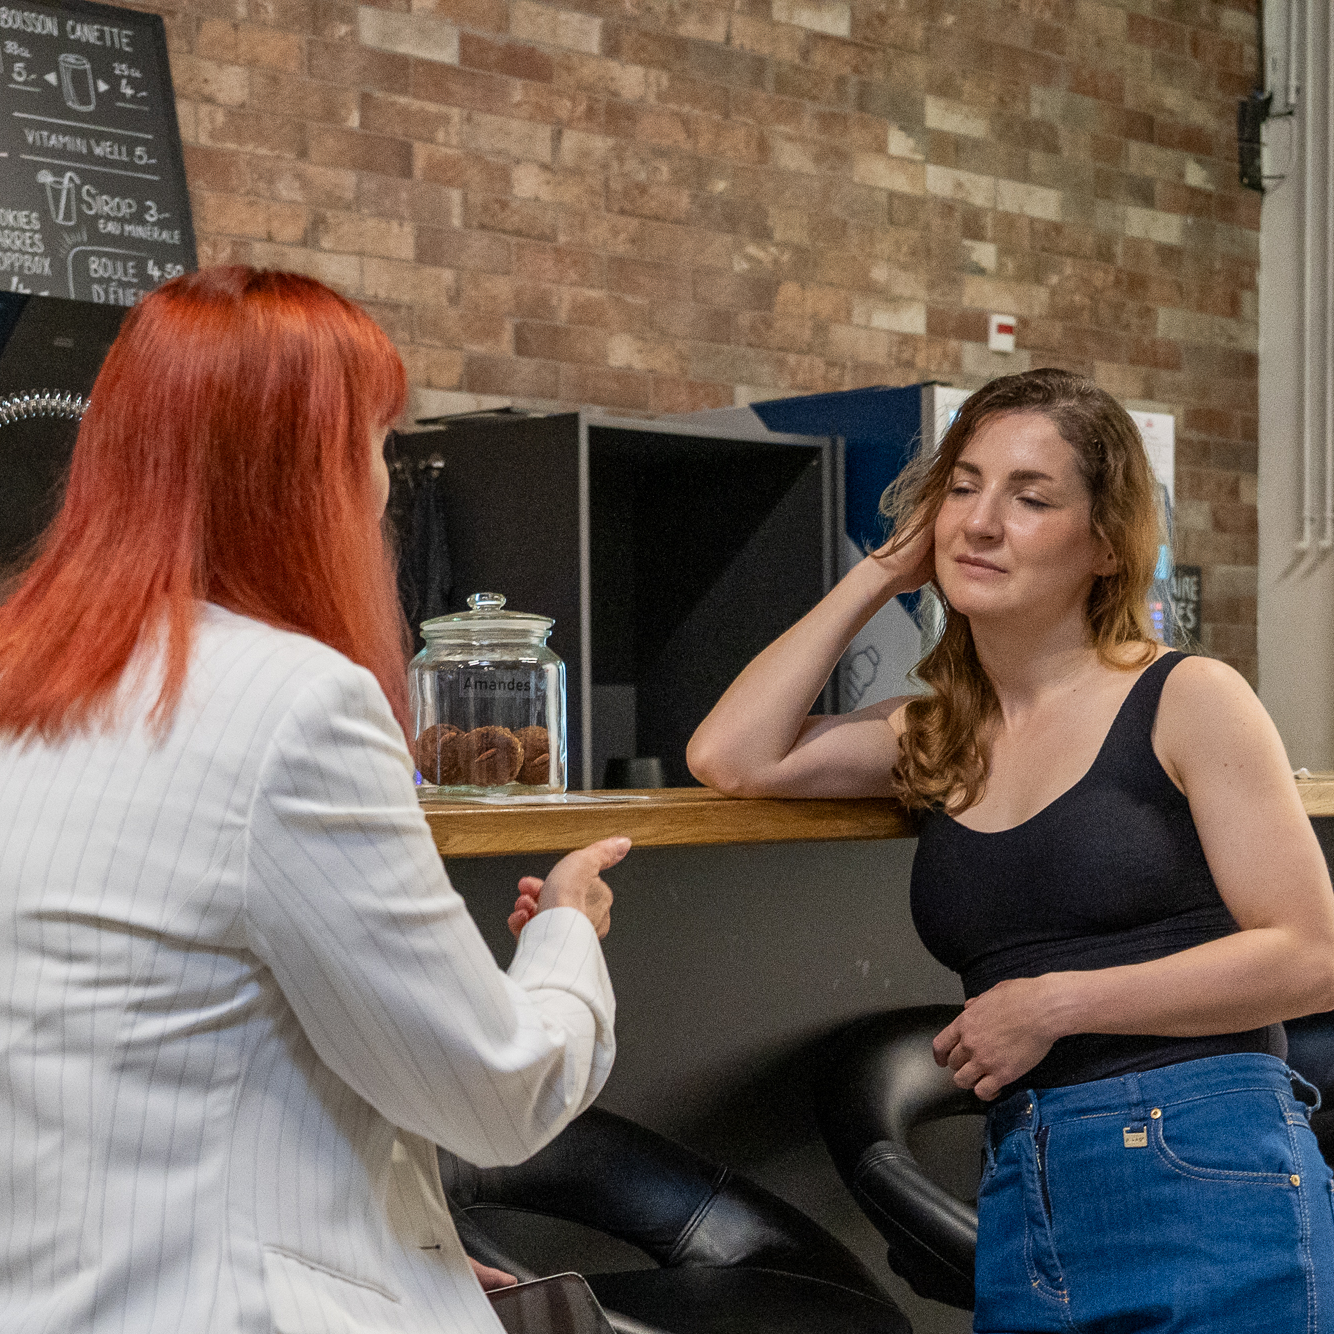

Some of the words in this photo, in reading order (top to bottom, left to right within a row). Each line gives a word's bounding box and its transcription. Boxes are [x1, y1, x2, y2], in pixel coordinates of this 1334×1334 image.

[66, 19, 134, 52] CANETTE
[24, 128, 87, 154] VITAMIN
[89, 138, 127, 160] WELL
[88, 256, 138, 282] BOULE
[463, 677, 531, 691] Amandes
